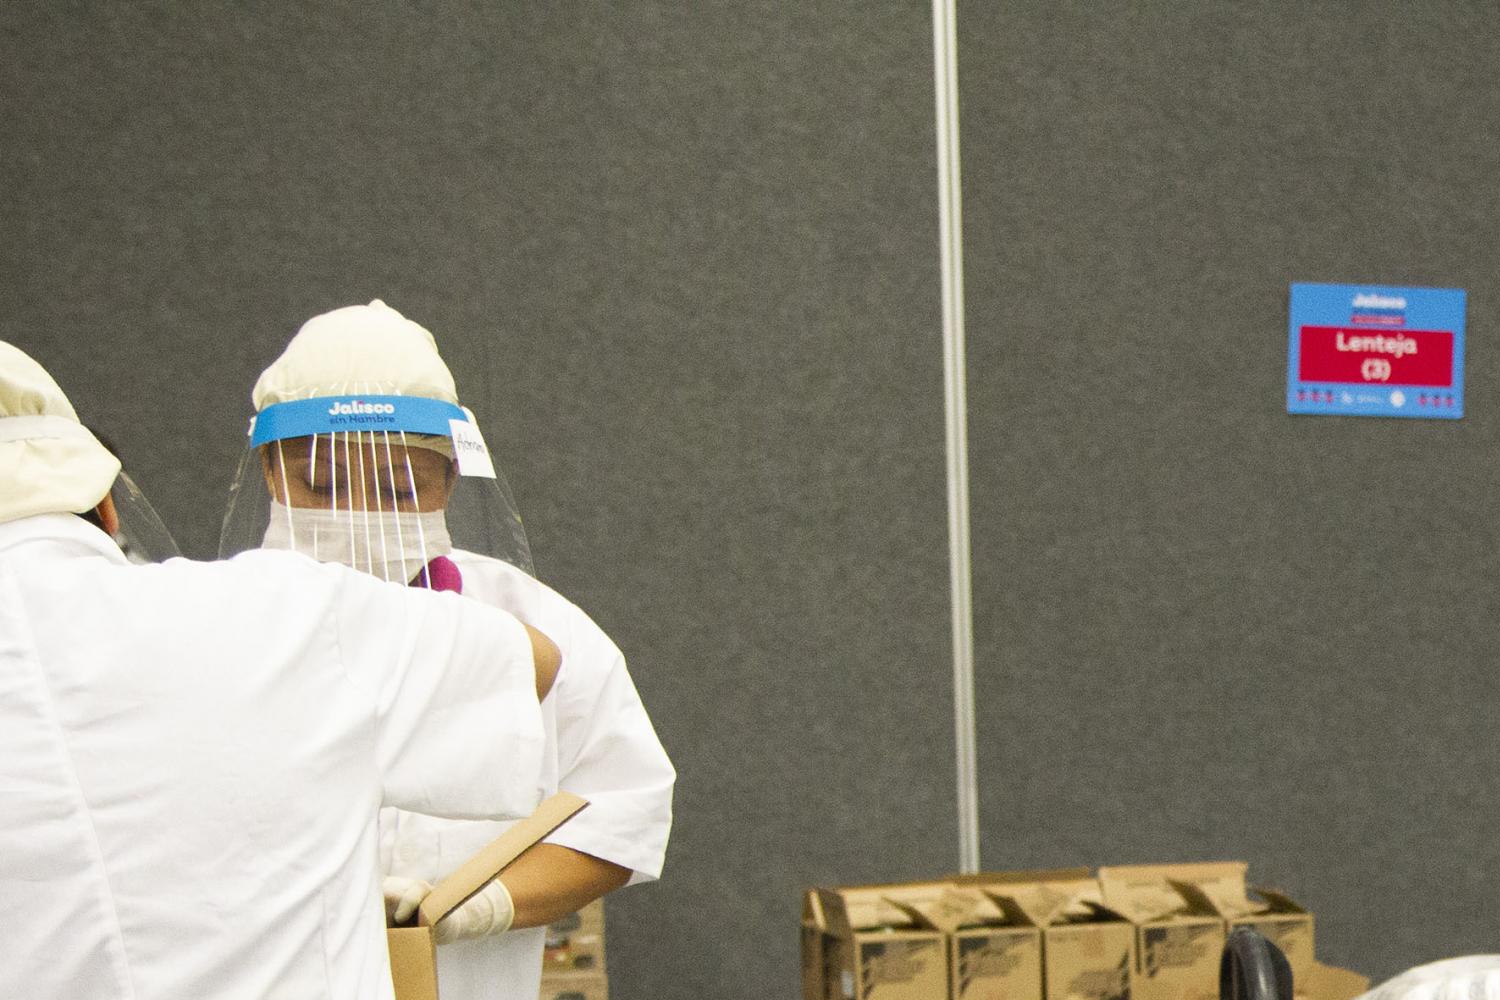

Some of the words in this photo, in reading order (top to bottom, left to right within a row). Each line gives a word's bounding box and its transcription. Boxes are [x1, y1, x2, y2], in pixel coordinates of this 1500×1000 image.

[1336, 331, 1417, 358] Lenteja
[1361, 358, 1391, 381] (3)
[329, 400, 395, 415] Jalisco
[329, 416, 346, 425] sin
[350, 414, 395, 425] Hambre
